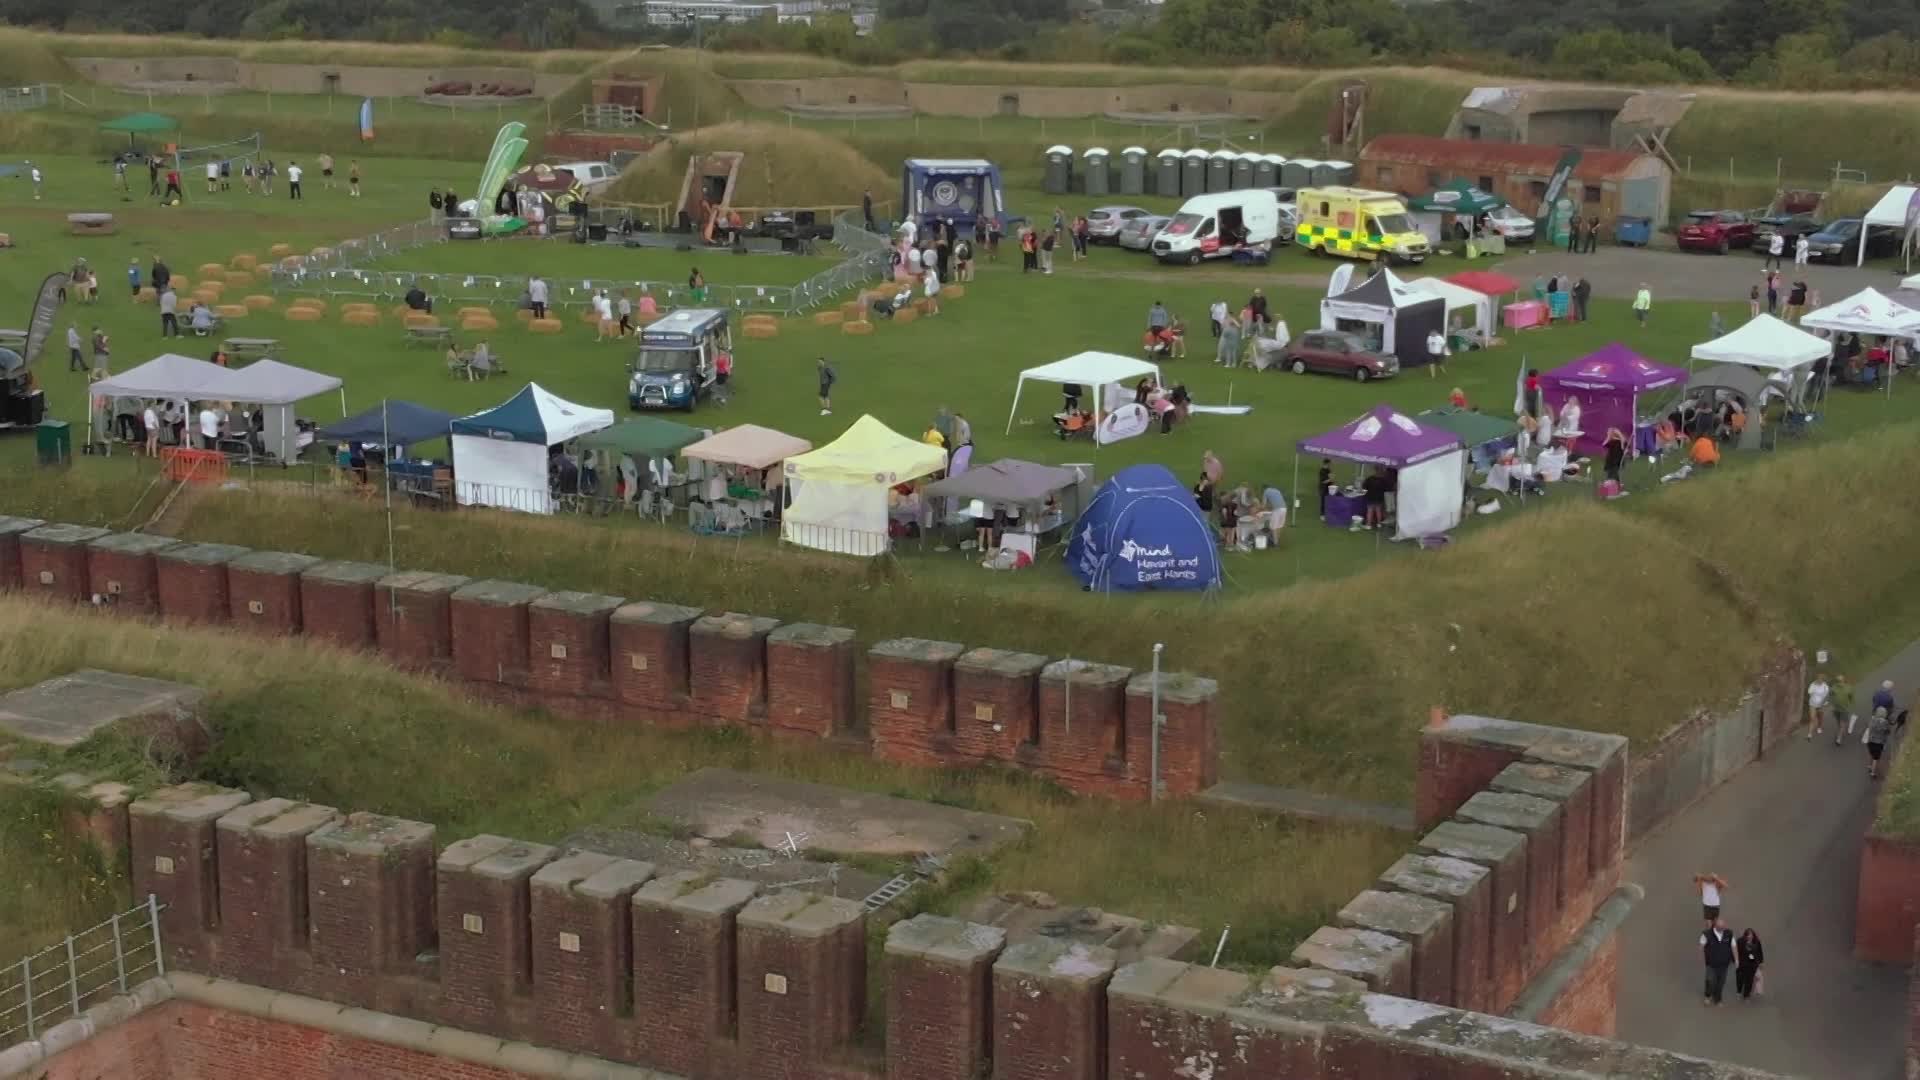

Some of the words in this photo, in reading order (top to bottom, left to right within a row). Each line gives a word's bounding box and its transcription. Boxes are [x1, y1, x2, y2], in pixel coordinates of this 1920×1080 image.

[1178, 556, 1198, 568] and
[1138, 571, 1162, 582] East
[1164, 569, 1197, 580] Hants
